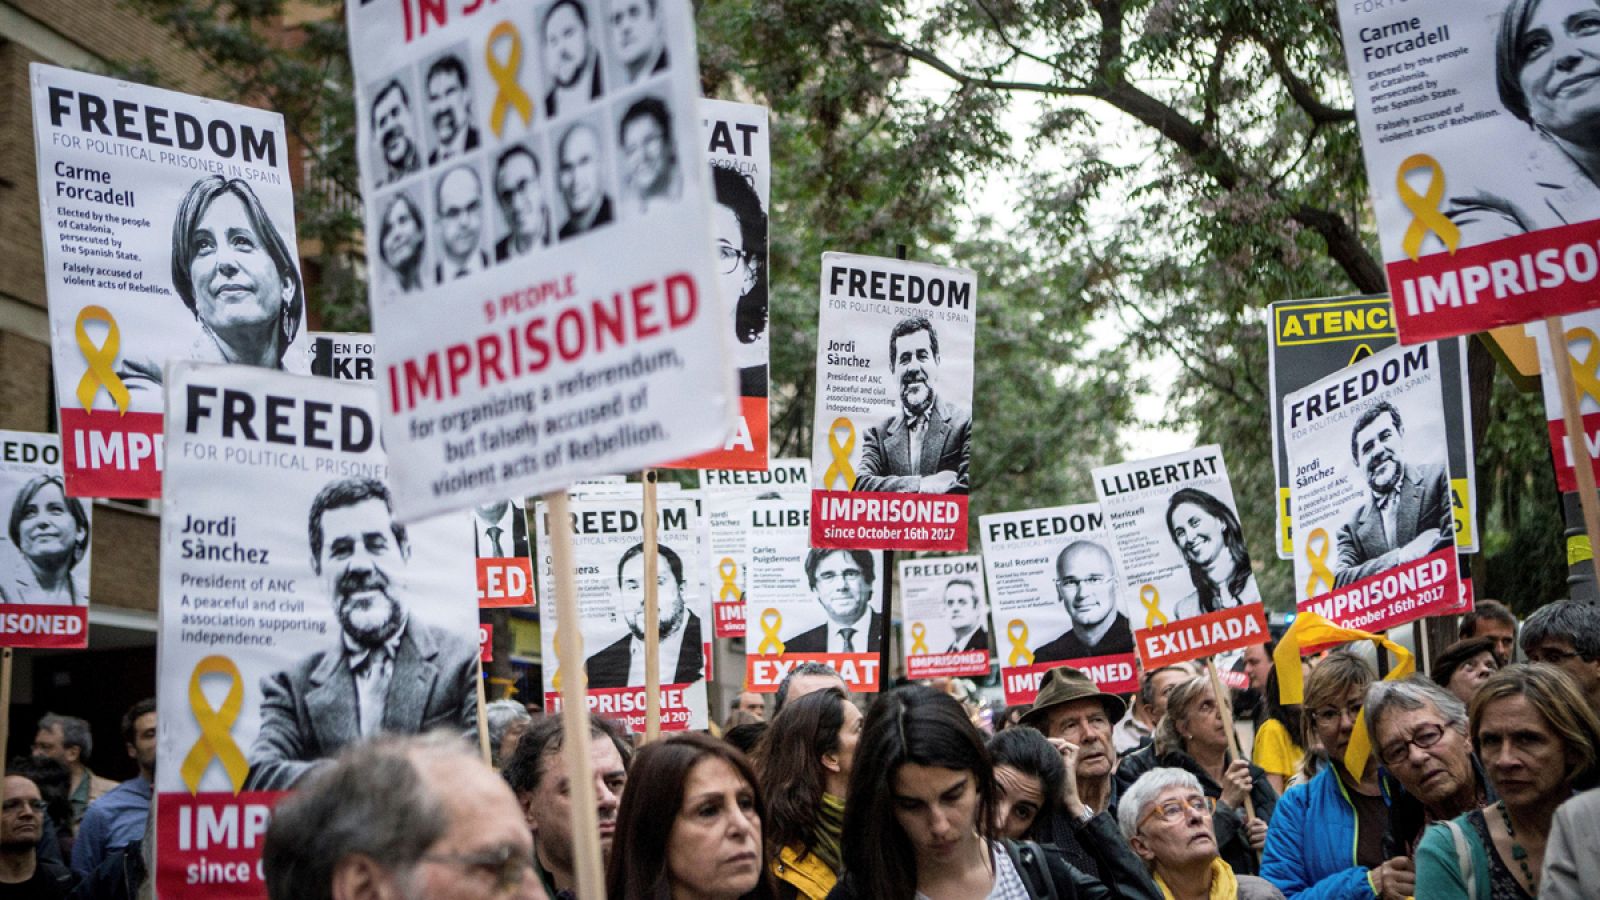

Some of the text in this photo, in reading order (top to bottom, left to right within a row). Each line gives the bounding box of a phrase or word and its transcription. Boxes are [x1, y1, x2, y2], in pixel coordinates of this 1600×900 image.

[1359, 17, 1421, 43] Carme
[1363, 24, 1450, 63] Forcadell
[1367, 47, 1468, 81] Elected by the people
[1369, 82, 1379, 91] of
[1372, 79, 1438, 104] persecuted by
[1373, 88, 1460, 113] the Spanish State.
[48, 86, 277, 167] FREEDOM
[1377, 104, 1464, 132] Falsely accused of
[1379, 109, 1500, 143] violent acts of Rebellion.
[53, 133, 280, 185] FOR POLITICAL PRISONER IN SPAIN
[55, 161, 111, 184] Carme
[56, 182, 134, 207] Forcadell
[58, 208, 150, 228] Elected by the people
[58, 220, 114, 236] of Catalonia,
[60, 234, 122, 248] persecuted by
[61, 243, 141, 261] the Spanish State.
[63, 263, 142, 280] Falsely accused of
[1403, 243, 1600, 316] IMPRISO
[63, 276, 172, 296] violent acts of Rebellion.
[484, 273, 577, 323] 9 PEOPLE
[830, 266, 970, 310] FREEDOM
[829, 300, 847, 309] FOR
[851, 302, 892, 315] POLITICAL
[895, 306, 934, 319] PRISONER
[947, 312, 969, 323] SPAIN
[388, 271, 699, 414] IMPRISONED
[828, 340, 855, 352] Jordi
[827, 354, 870, 368] Sànchez
[827, 372, 882, 384] President of ANC
[832, 386, 859, 395] peaceful
[1291, 344, 1429, 428] FREEDOM
[409, 349, 684, 440] for organizing a referendum,
[826, 394, 895, 406] association supporting
[1292, 428, 1307, 440] FOR
[1310, 412, 1349, 435] POLITICAL
[1393, 385, 1404, 395] IN
[1405, 374, 1431, 391] SPAIN
[186, 384, 374, 453] FREED
[444, 385, 649, 463] but falsely accused of
[184, 442, 217, 459] FOR
[225, 447, 309, 472] POLITICAL
[432, 421, 668, 495] violent acts of Rebellion.
[1296, 458, 1320, 477] Jordi
[706, 467, 806, 484] FREEDOM
[1101, 456, 1217, 496] LLIBERTAT
[544, 508, 687, 535] REEDM
[821, 497, 959, 523] IMPRISONED
[181, 514, 236, 537] Jordi
[824, 525, 955, 541] since October 16th 2017
[989, 512, 1103, 542] FREEDOM
[1112, 519, 1136, 530] Serret
[181, 539, 269, 564] Sànchez
[904, 562, 978, 577] FREEDOM
[181, 573, 296, 593] President of ANC
[180, 596, 304, 615] A peaceful and civil
[1388, 597, 1415, 617] 16th
[1417, 586, 1445, 604] 2017
[181, 614, 326, 634] association supporting
[1145, 614, 1260, 659] EXILIADA
[181, 630, 276, 646] independence.
[753, 660, 878, 684] EXAT
[186, 857, 250, 884] since
